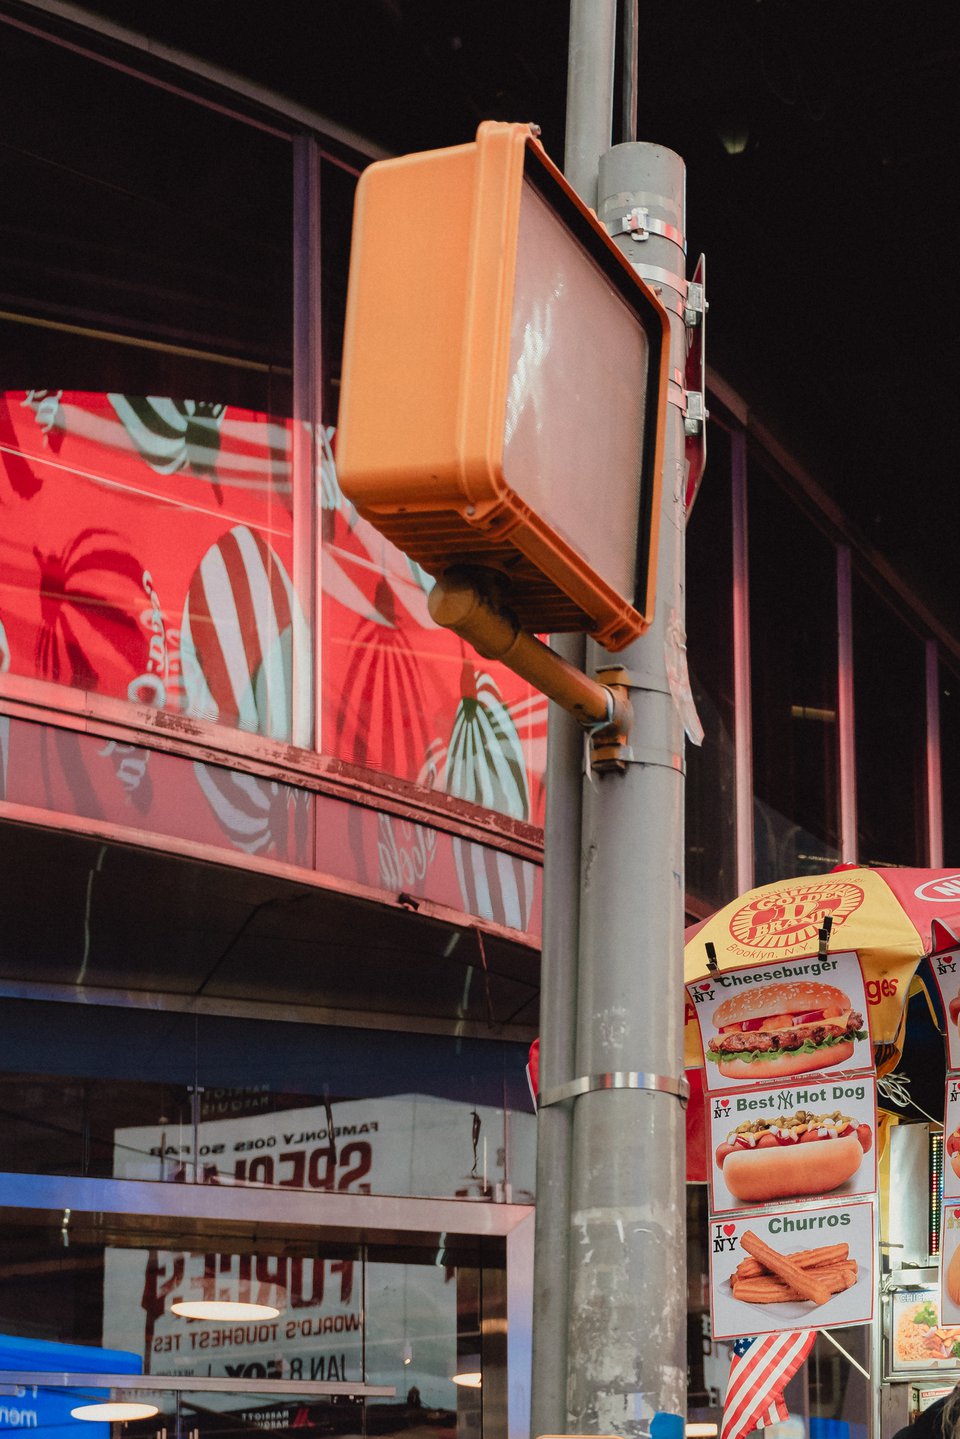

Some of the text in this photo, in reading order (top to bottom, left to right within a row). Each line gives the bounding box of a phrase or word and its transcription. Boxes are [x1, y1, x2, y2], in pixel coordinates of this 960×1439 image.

[756, 888, 848, 911] GOLDEN
[747, 907, 834, 940] BRAND
[936, 957, 943, 966] I
[720, 959, 839, 989] Cheeseburger
[936, 963, 957, 976] NY
[693, 985, 700, 995] I
[693, 990, 716, 1004] NY
[952, 1083, 957, 1093] I
[715, 1099, 721, 1110] I
[736, 1095, 775, 1112] Best
[796, 1088, 827, 1104] Hot
[832, 1086, 866, 1101] Dog
[713, 1107, 732, 1119] NY
[768, 1213, 851, 1234] Churros
[715, 1225, 722, 1239] I
[713, 1236, 738, 1253] NY
